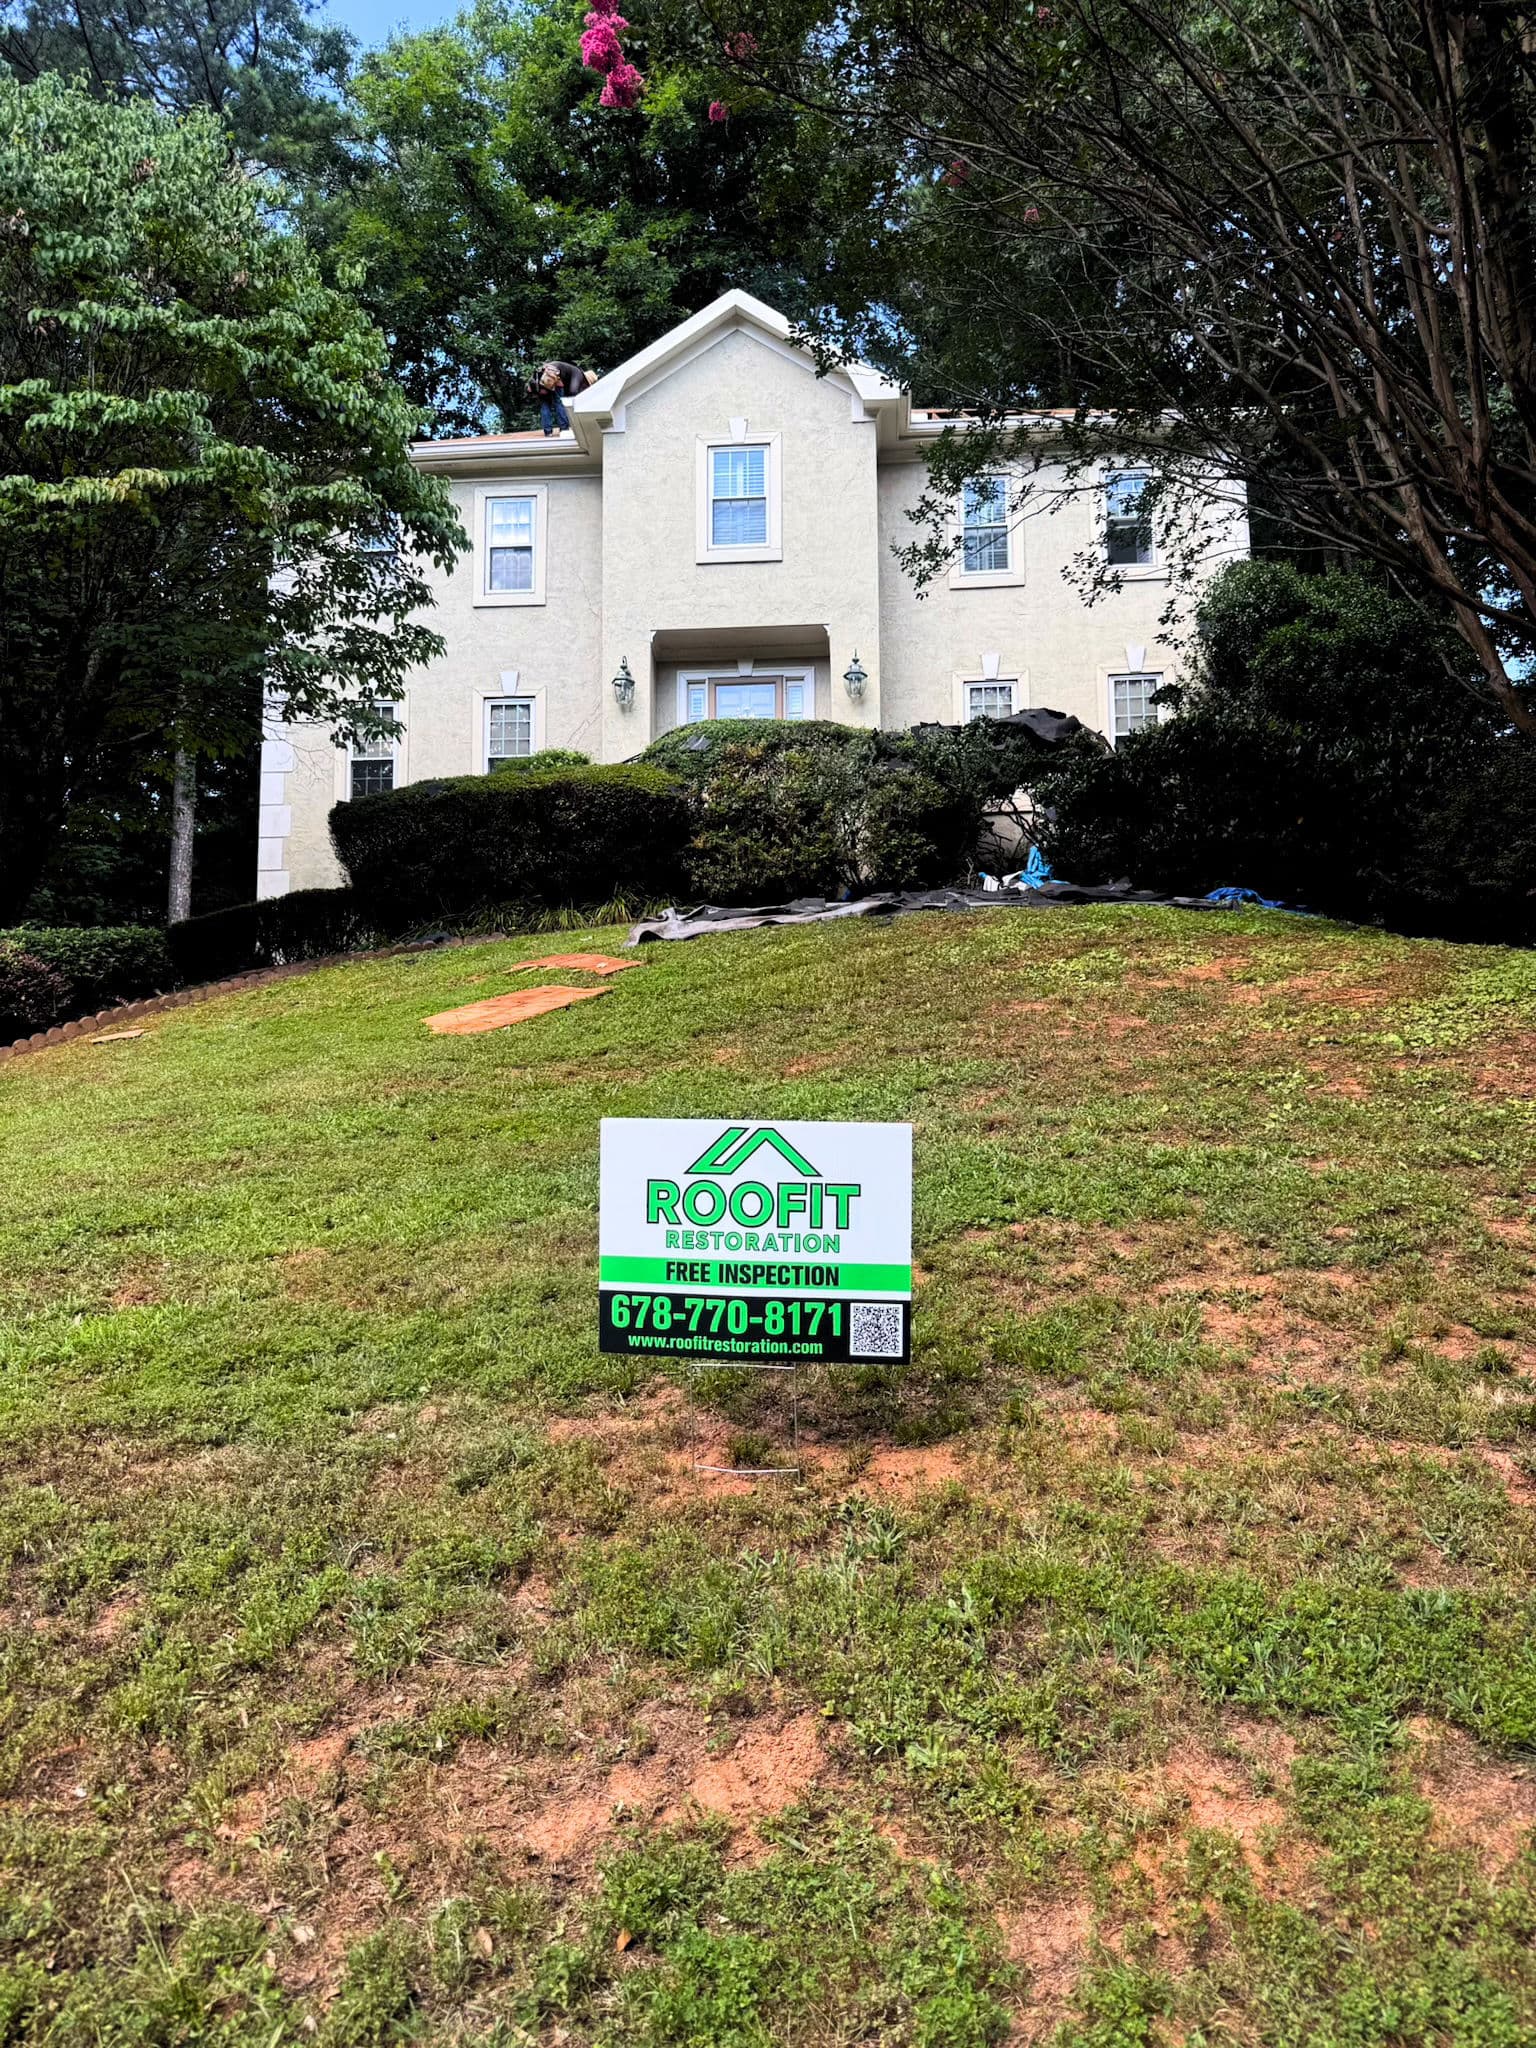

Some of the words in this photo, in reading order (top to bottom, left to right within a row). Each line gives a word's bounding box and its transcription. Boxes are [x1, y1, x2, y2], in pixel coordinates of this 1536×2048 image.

[646, 1179, 861, 1229] ROOFIT
[665, 1230, 841, 1253] RESTORATION
[665, 1261, 711, 1283] FREE
[718, 1263, 840, 1286] INSPECTION
[611, 1294, 842, 1336] 678-770-8171
[628, 1334, 823, 1354] www.roofitrestoration.com
